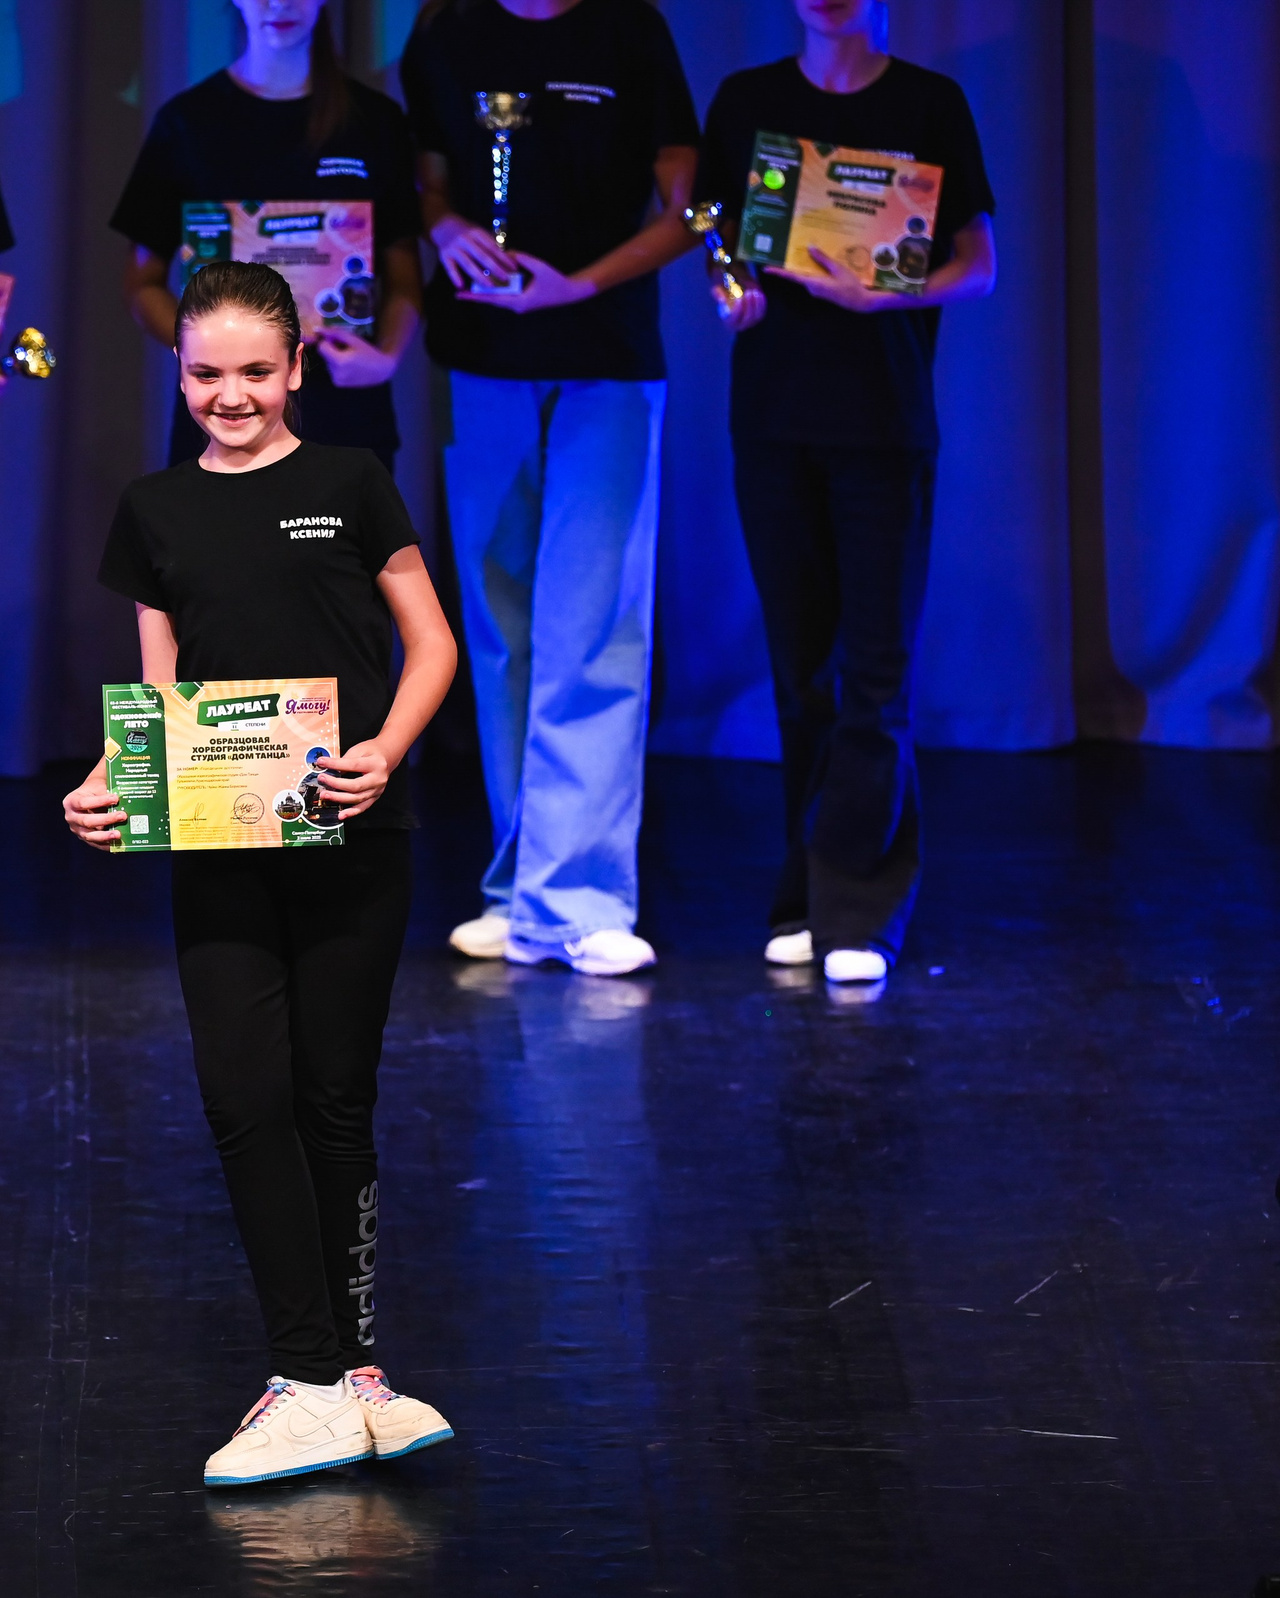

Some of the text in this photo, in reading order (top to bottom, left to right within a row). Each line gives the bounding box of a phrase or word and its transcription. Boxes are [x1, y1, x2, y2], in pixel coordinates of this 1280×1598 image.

[279, 516, 343, 529] БАРАНОВА
[289, 528, 336, 540] КСЕНИЯ
[206, 699, 271, 718] ЛАУРЕАТ
[297, 699, 331, 716] могу!
[123, 720, 149, 728] ЛЕТО
[209, 736, 270, 745] ОБРАЗЦОВАЯ
[192, 743, 288, 754] ХОРЕОГРАФИЧЕСКАЯ
[190, 752, 290, 762] СТУДИЯ «ДОМ ТАНЦА»
[348, 1179, 379, 1346] adidas
